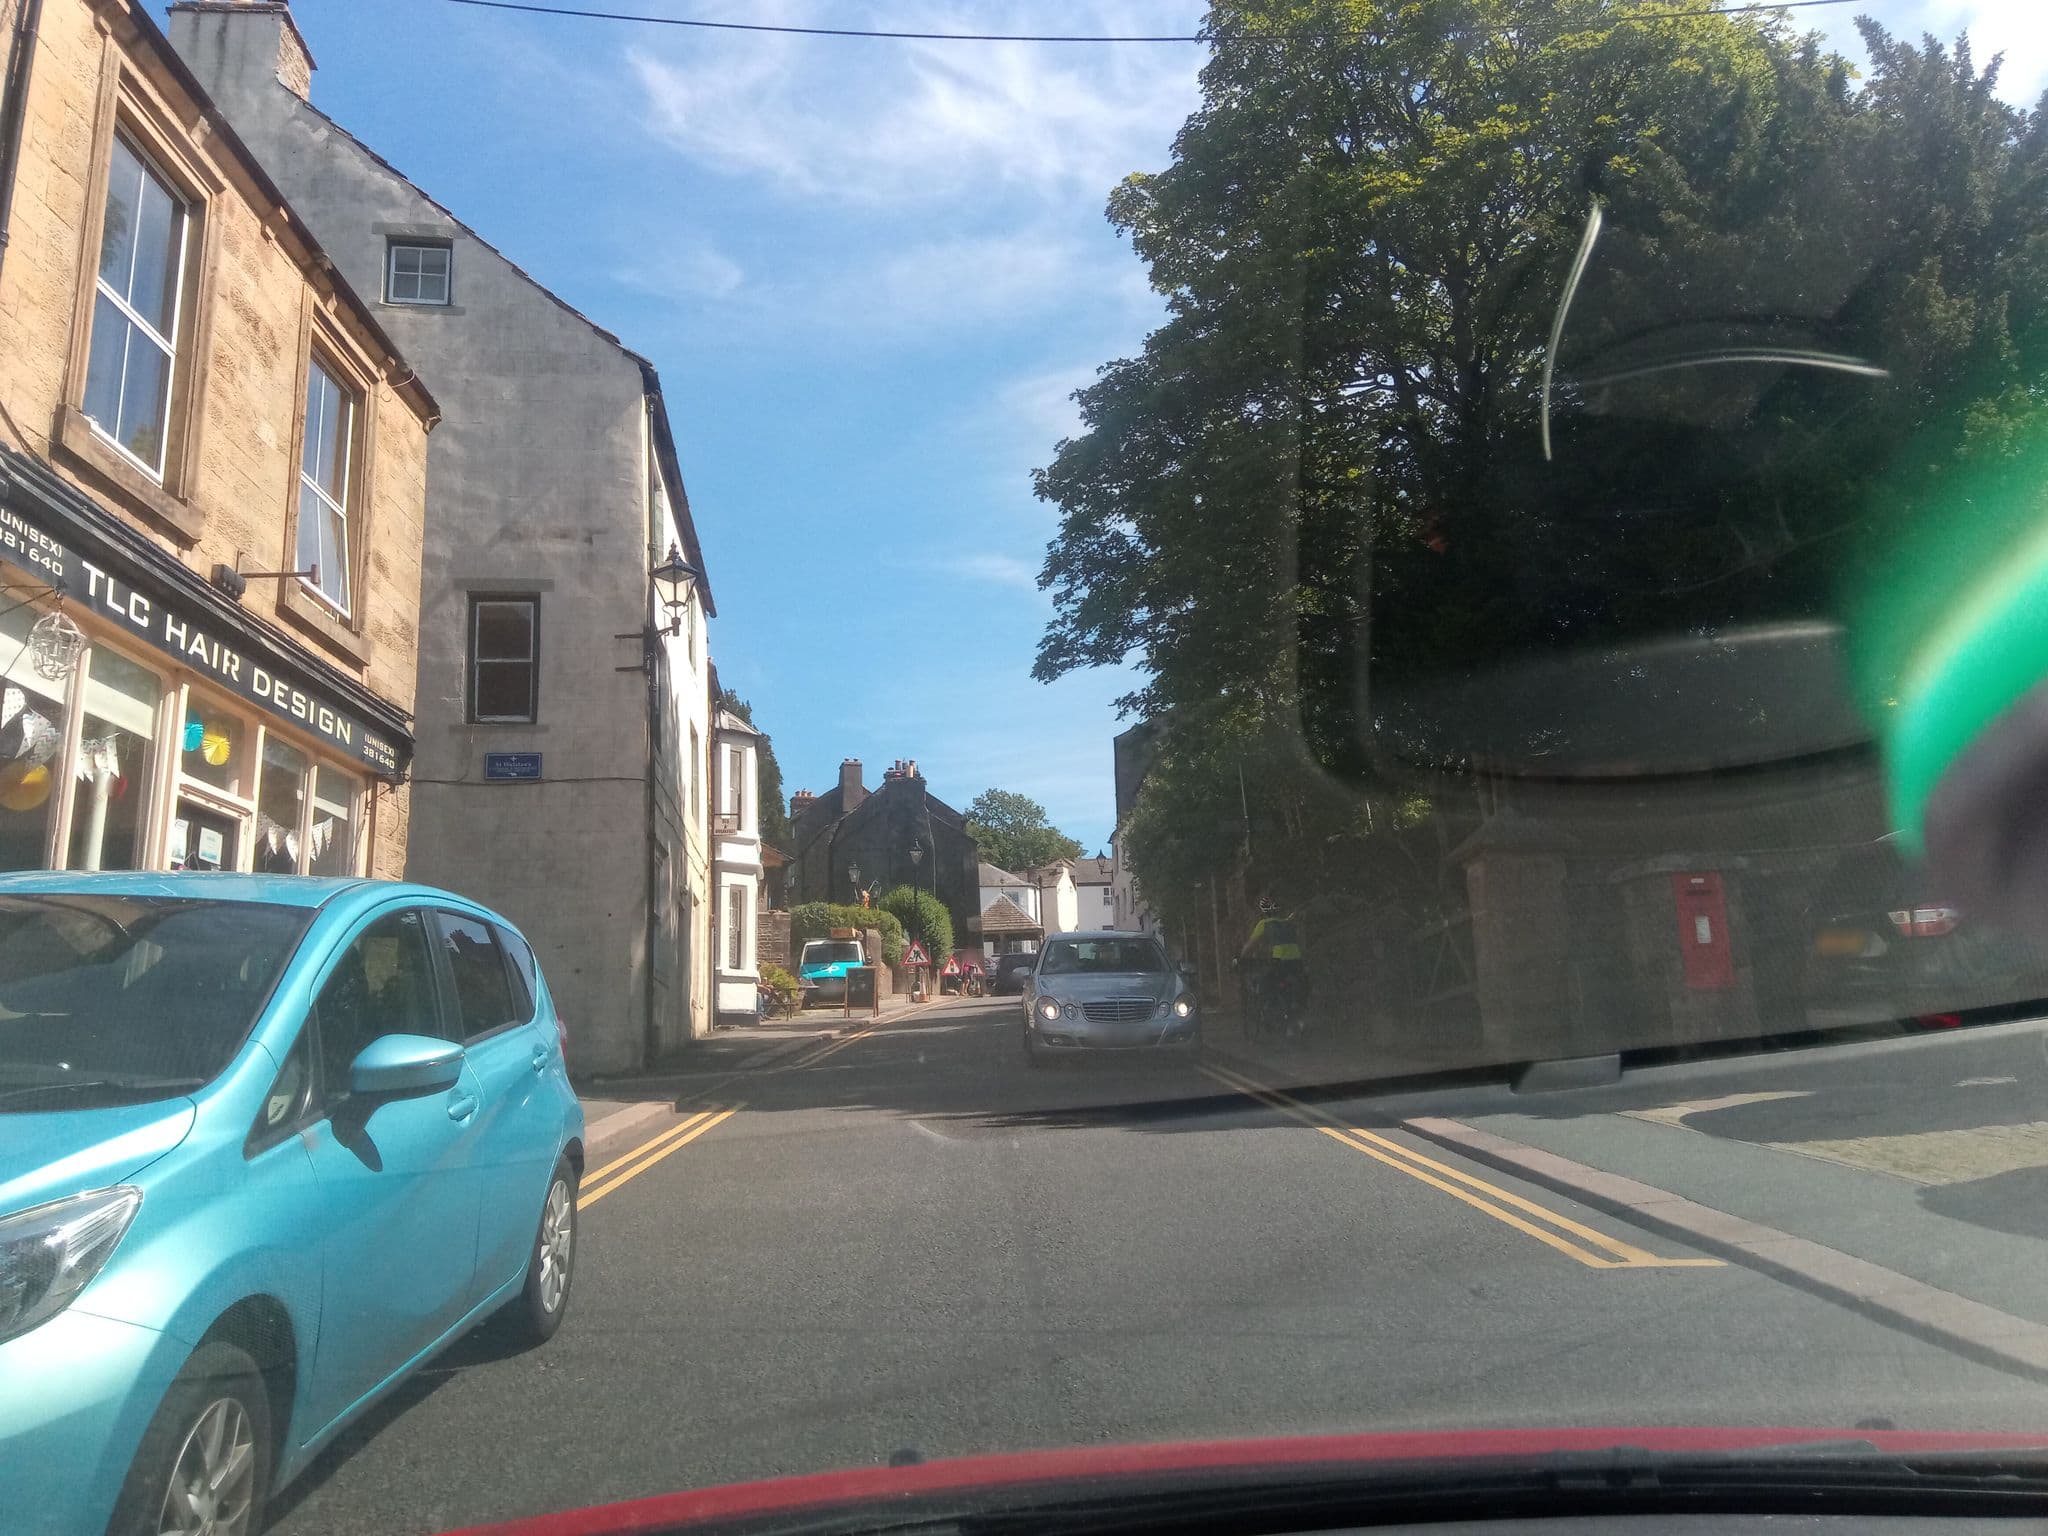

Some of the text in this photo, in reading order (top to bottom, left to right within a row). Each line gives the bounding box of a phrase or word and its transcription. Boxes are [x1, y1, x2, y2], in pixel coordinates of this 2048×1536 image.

[0, 526, 63, 577] 81640
[82, 560, 351, 745] TLC HAIR DESIGN
[363, 745, 395, 769] 381640
